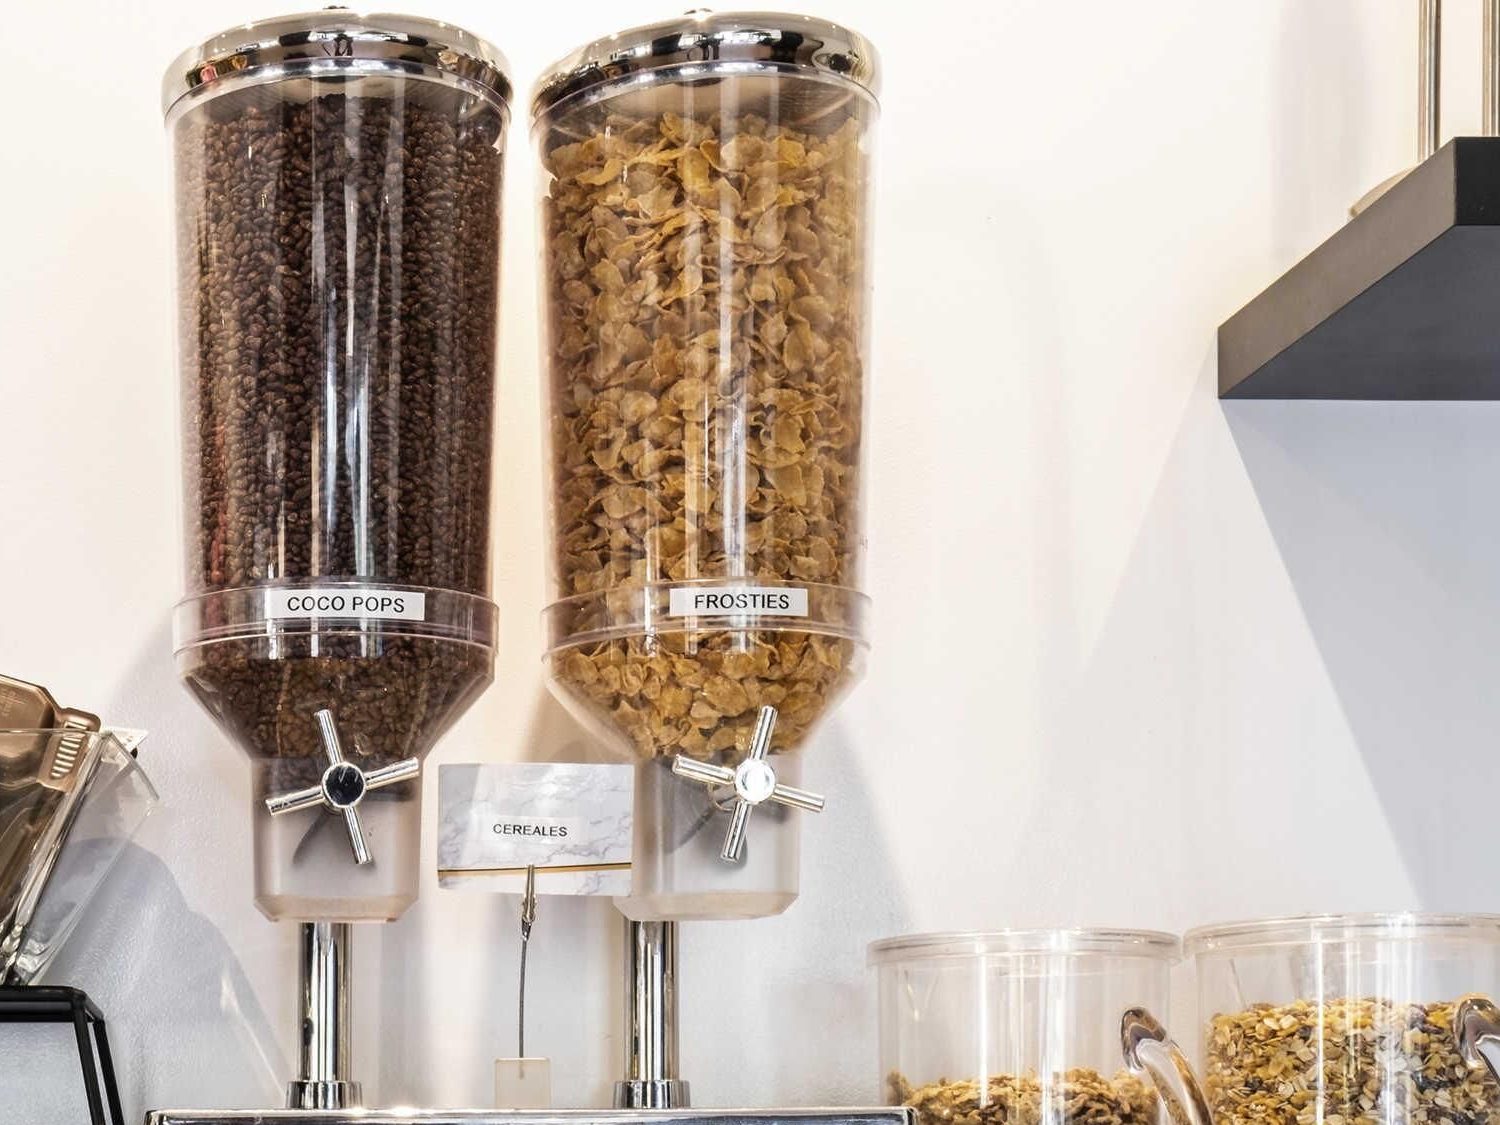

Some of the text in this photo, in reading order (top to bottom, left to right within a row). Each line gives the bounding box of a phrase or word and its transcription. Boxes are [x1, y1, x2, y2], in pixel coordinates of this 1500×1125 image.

[287, 596, 405, 613] COCO POPS
[694, 594, 790, 609] FROSTIES
[493, 824, 568, 837] CEREALES
